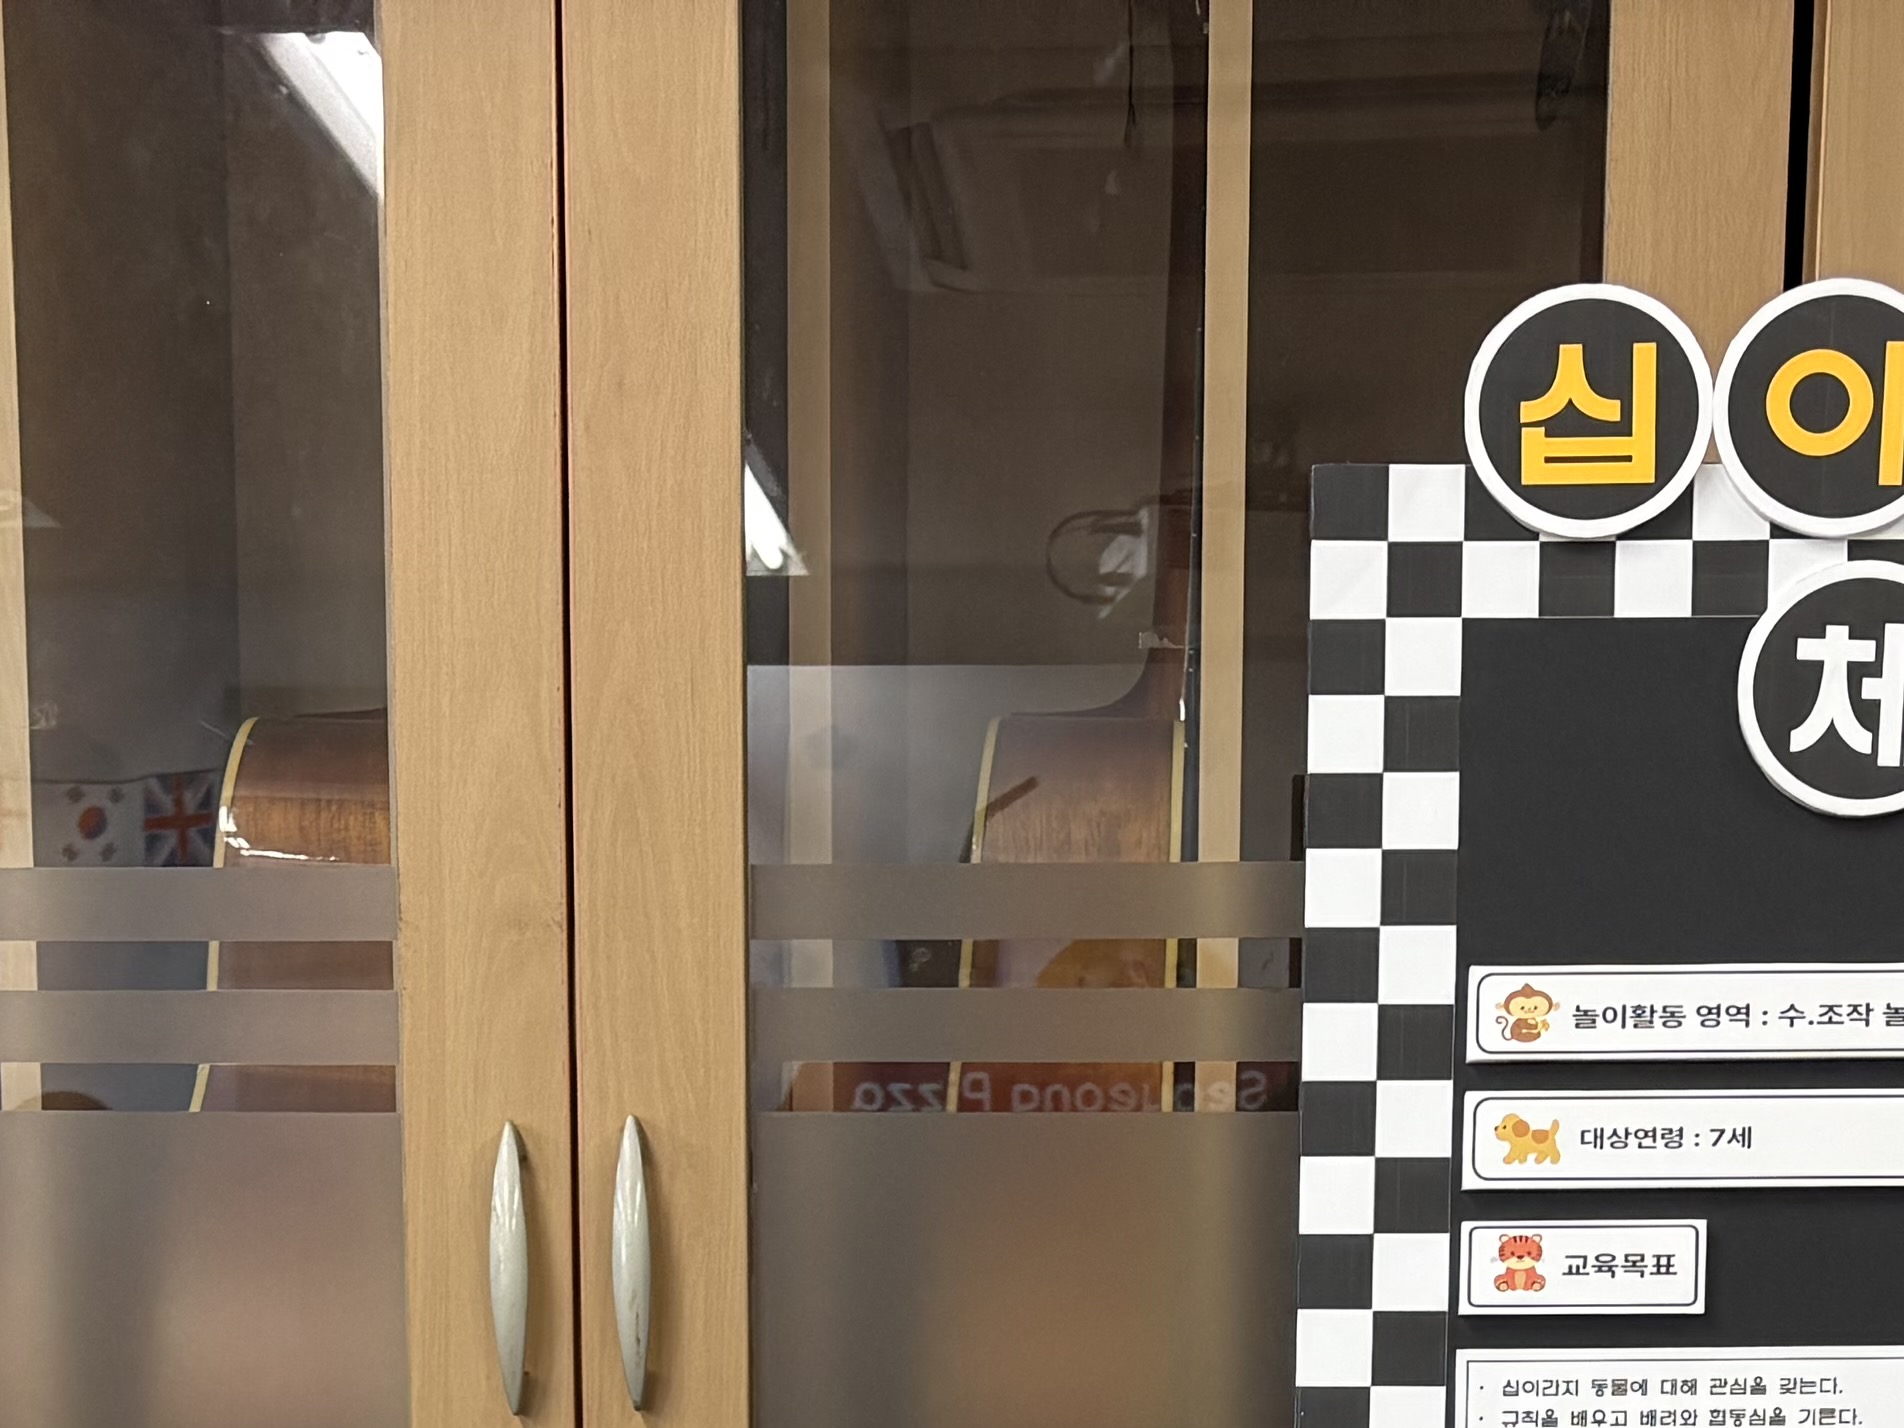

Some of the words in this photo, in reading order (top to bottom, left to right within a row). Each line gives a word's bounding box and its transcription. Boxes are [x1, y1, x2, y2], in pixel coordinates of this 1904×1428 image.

[1572, 1003, 1687, 1030] 놀이활동
[1695, 1003, 1751, 1029] 영역
[1777, 1002, 1875, 1028] 수.조작
[1580, 1126, 1684, 1150] 대상연령
[1709, 1125, 1752, 1150] 7세
[1562, 1253, 1678, 1279] 교육목표
[1502, 1379, 1579, 1397] 십이간지
[1591, 1378, 1648, 1398] 동물에
[1660, 1378, 1698, 1396] 대해
[1709, 1375, 1767, 1396] 관심을
[1779, 1376, 1843, 1395] 갖는다.
[1501, 1408, 1559, 1428] 규칙을
[1570, 1409, 1628, 1428] 배우고
[1639, 1408, 1698, 1427] 배려와
[1708, 1406, 1787, 1428] 협동심을
[1798, 1407, 1863, 1426] 기른다.
